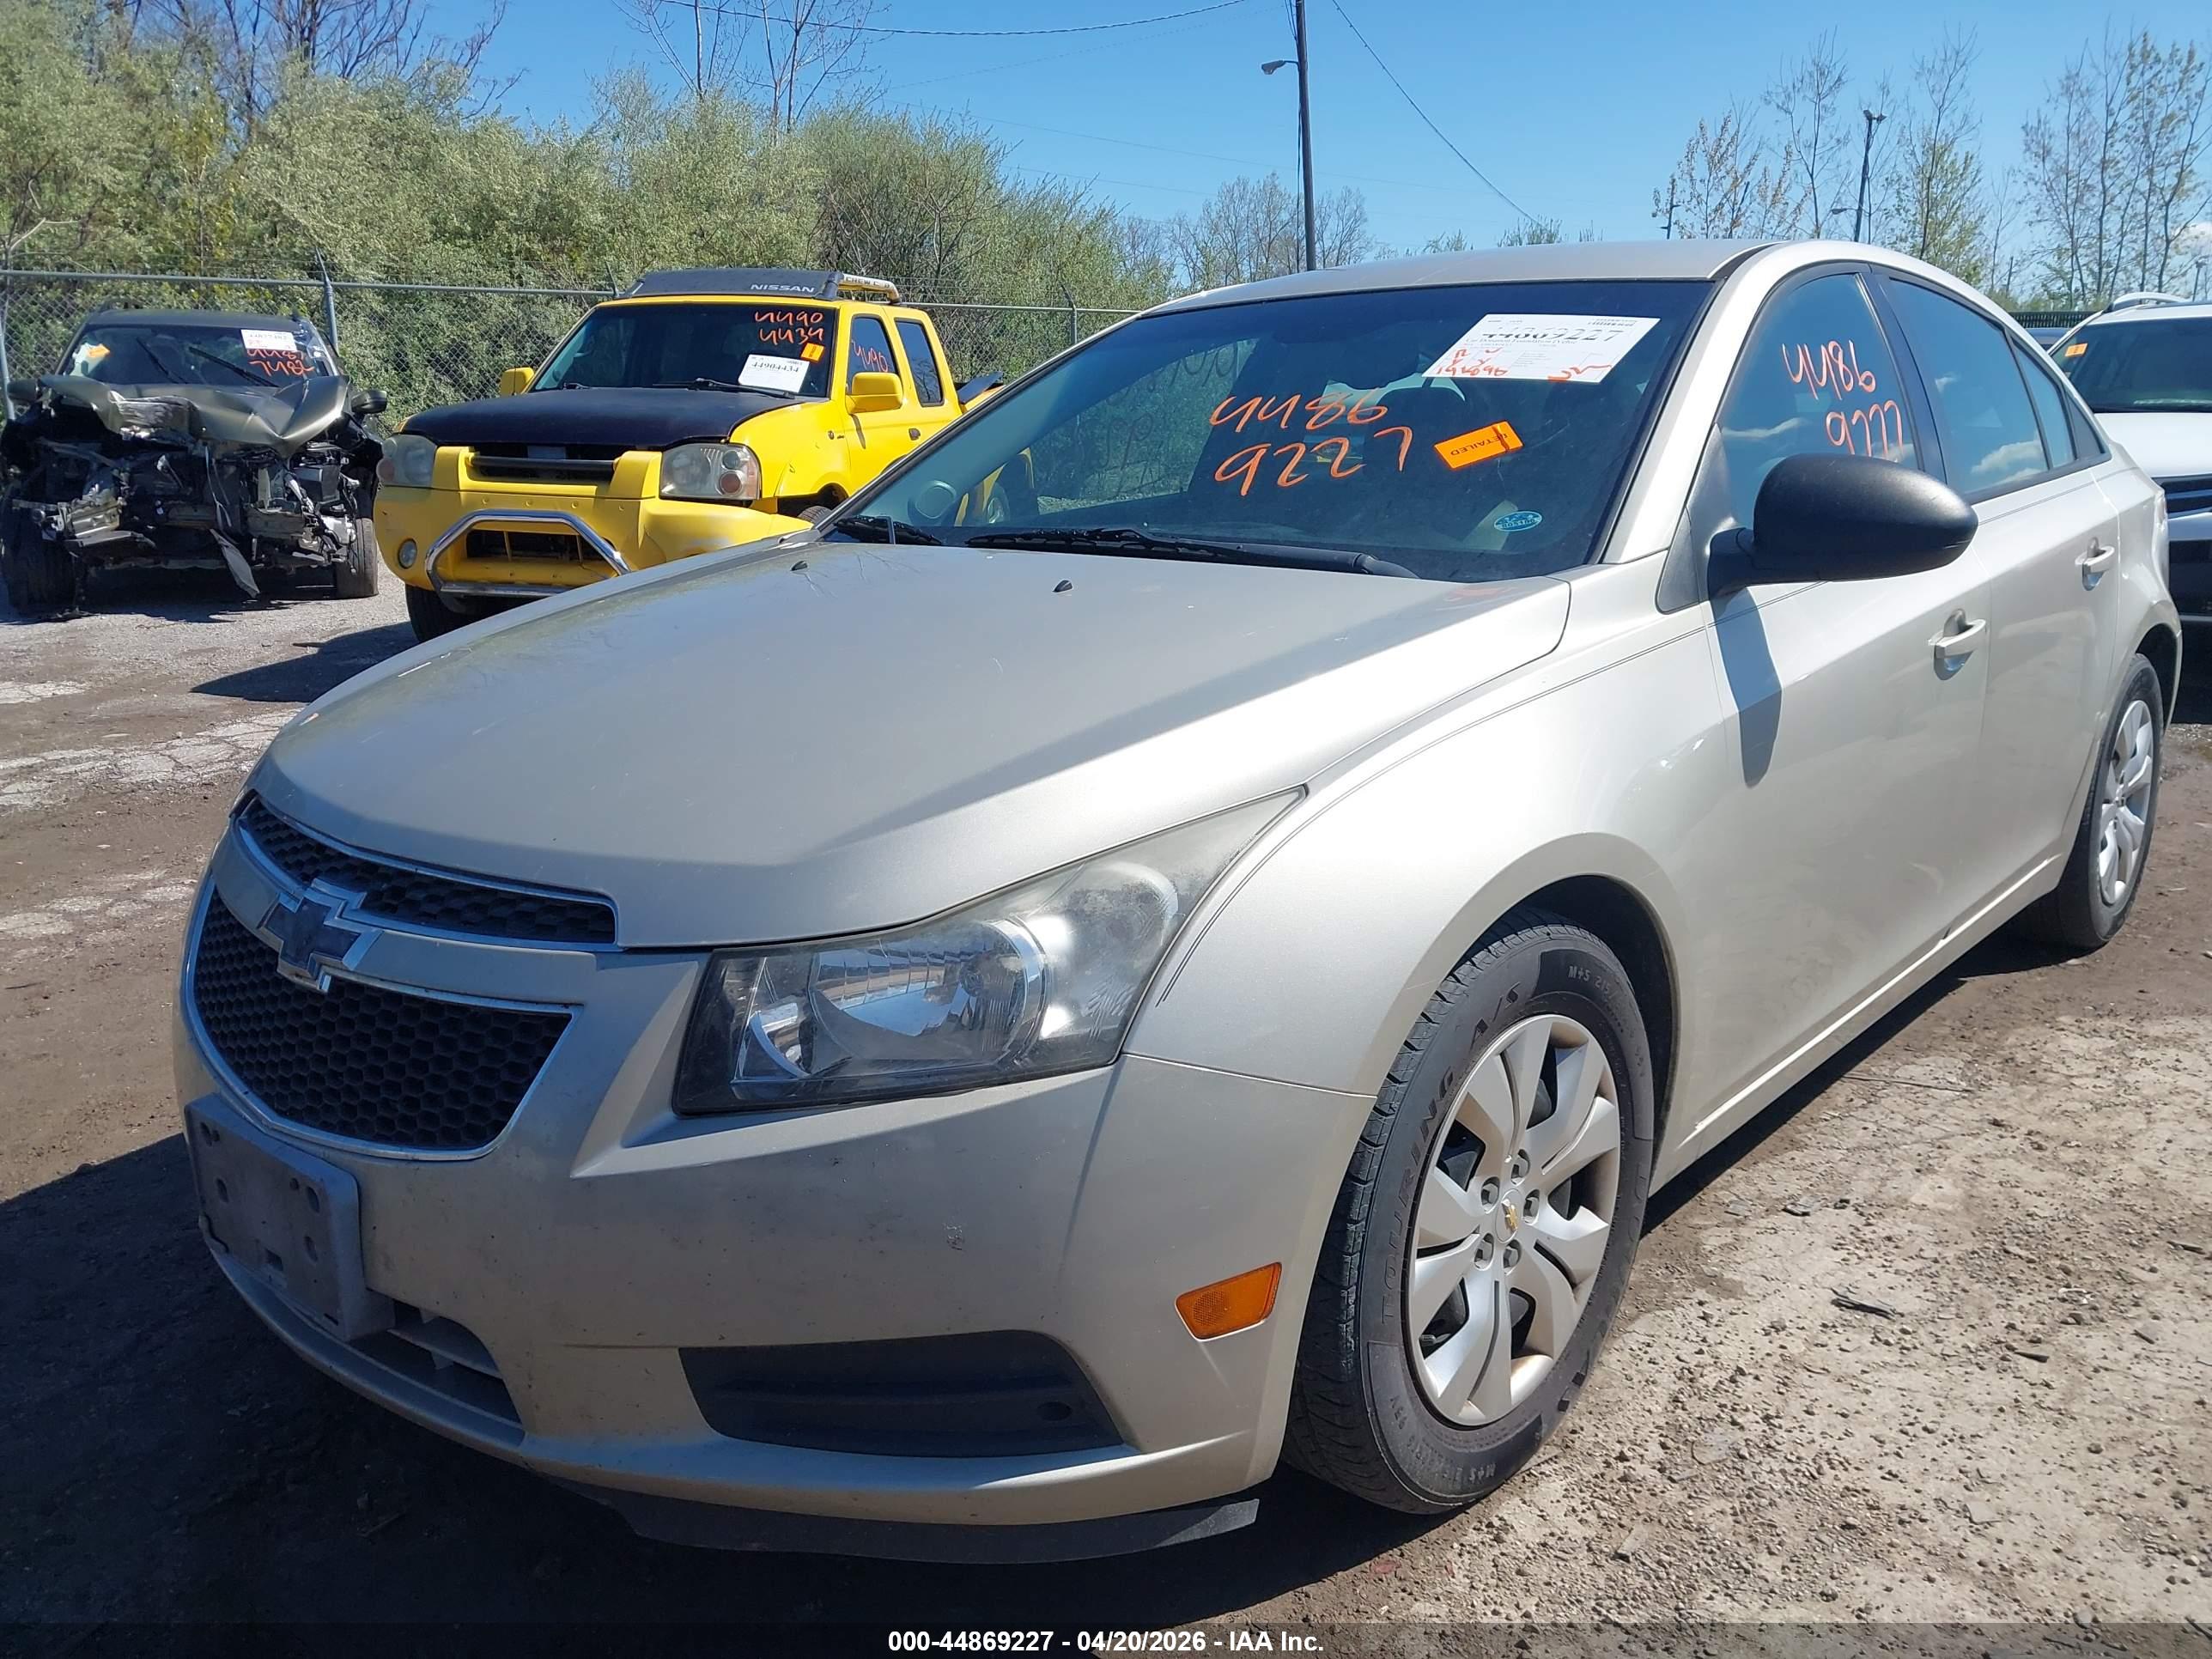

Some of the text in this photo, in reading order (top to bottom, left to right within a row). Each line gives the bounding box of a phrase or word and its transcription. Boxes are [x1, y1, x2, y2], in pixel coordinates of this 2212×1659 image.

[750, 283, 815, 293] NISSAN
[755, 311, 823, 327] 4490
[1781, 339, 1876, 401] 4486
[1209, 387, 1389, 433] 4486
[1214, 426, 1413, 496] 9227
[1380, 1065, 1457, 1326] TOURING
